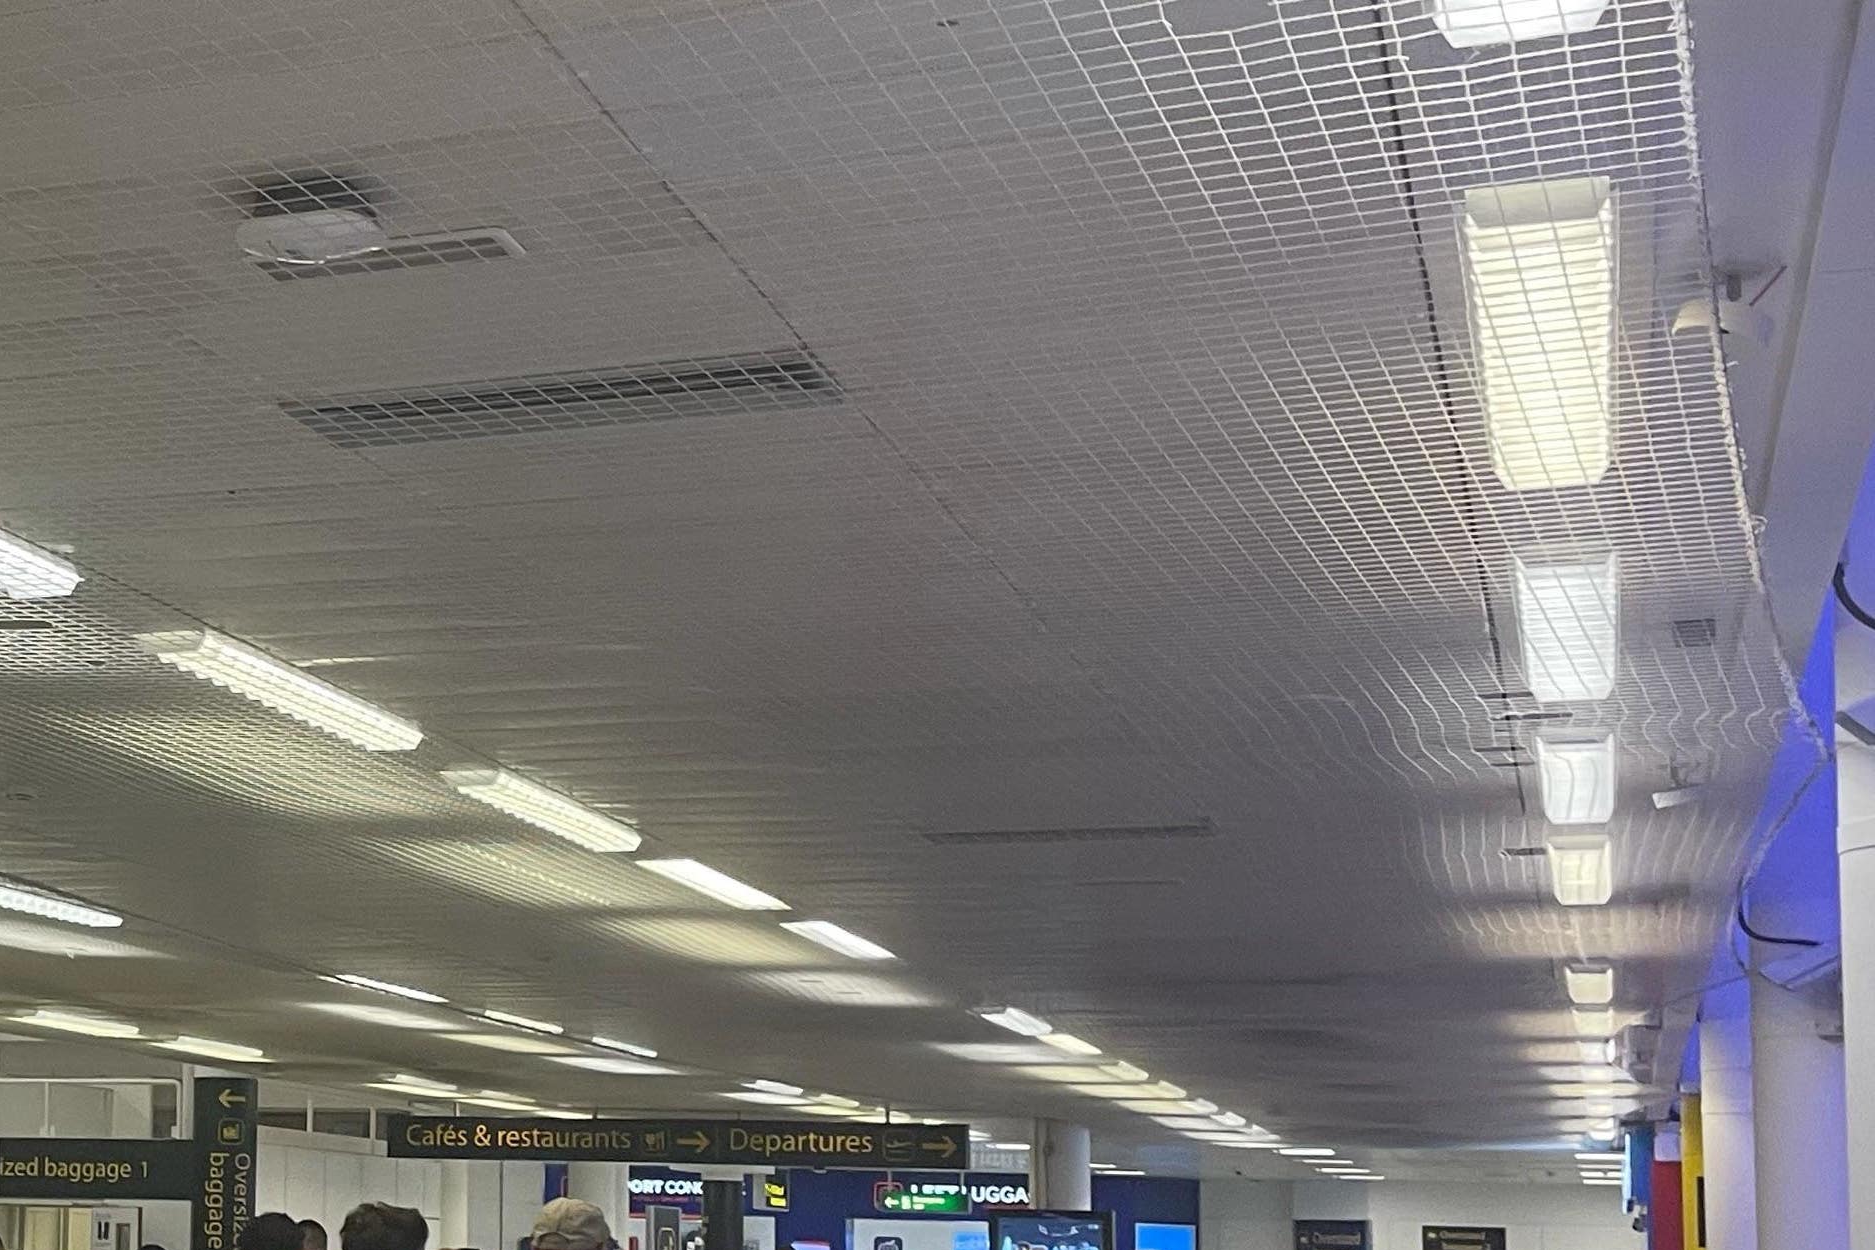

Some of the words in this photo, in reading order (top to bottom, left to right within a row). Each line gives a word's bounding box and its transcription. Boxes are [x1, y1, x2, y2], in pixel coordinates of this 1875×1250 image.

[406, 1123, 468, 1147] Cafés
[474, 1125, 491, 1147] &
[497, 1127, 632, 1150] restaurants
[729, 1127, 874, 1157] Departures
[44, 1156, 132, 1183] baggage
[627, 1179, 665, 1195] ORT
[961, 1185, 1031, 1204] UGGA
[204, 1152, 230, 1250] baggage
